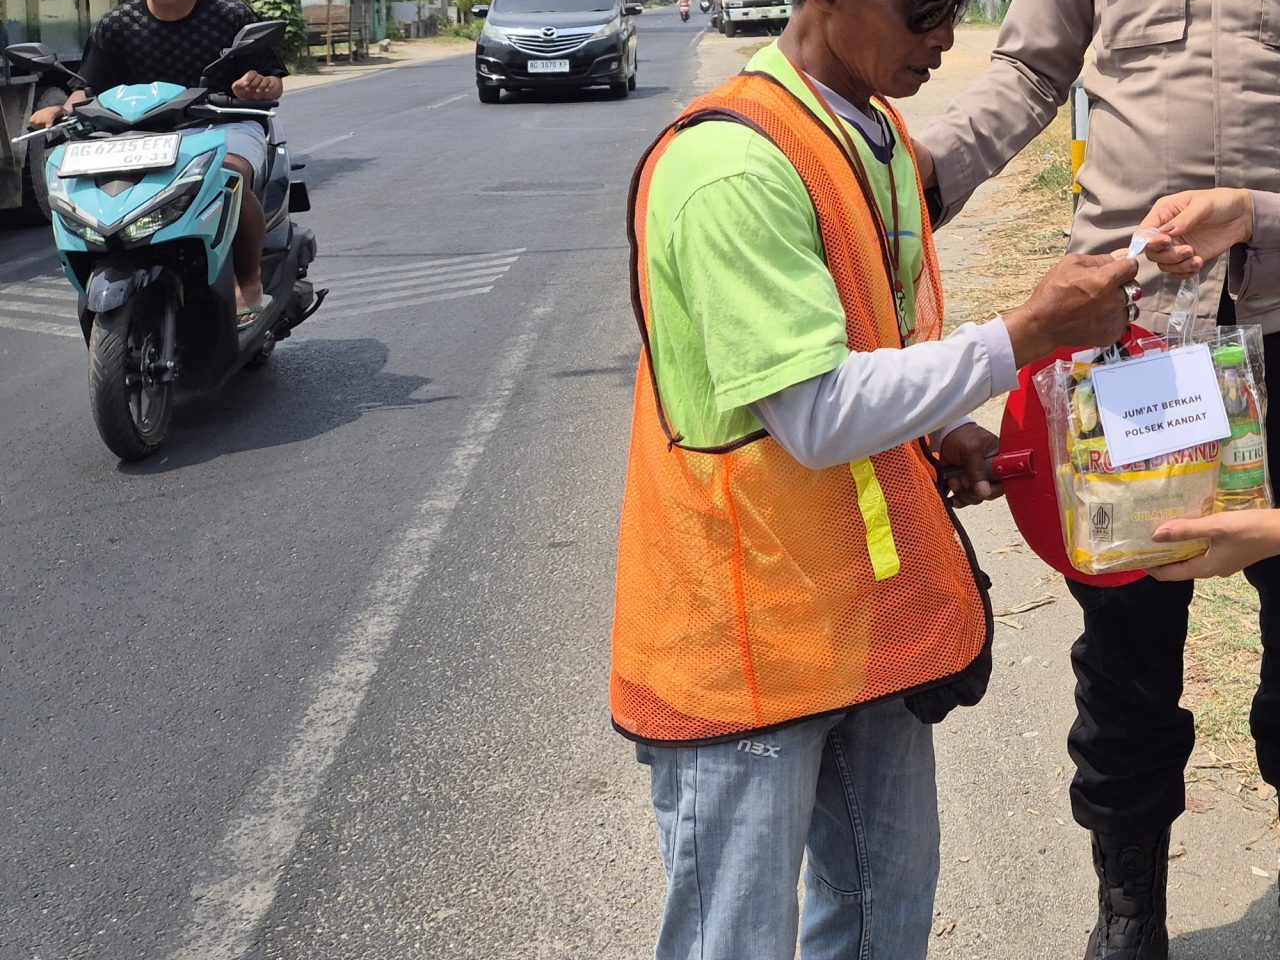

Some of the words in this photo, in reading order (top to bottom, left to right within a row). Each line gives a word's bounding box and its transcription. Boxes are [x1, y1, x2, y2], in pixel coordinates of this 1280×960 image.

[70, 144, 92, 158] AG
[142, 137, 173, 151] EFK
[1122, 404, 1158, 420] JUM'AT
[1162, 395, 1202, 410] BERKAH
[1124, 423, 1165, 438] POLSEK
[1167, 412, 1208, 428] KANDAT
